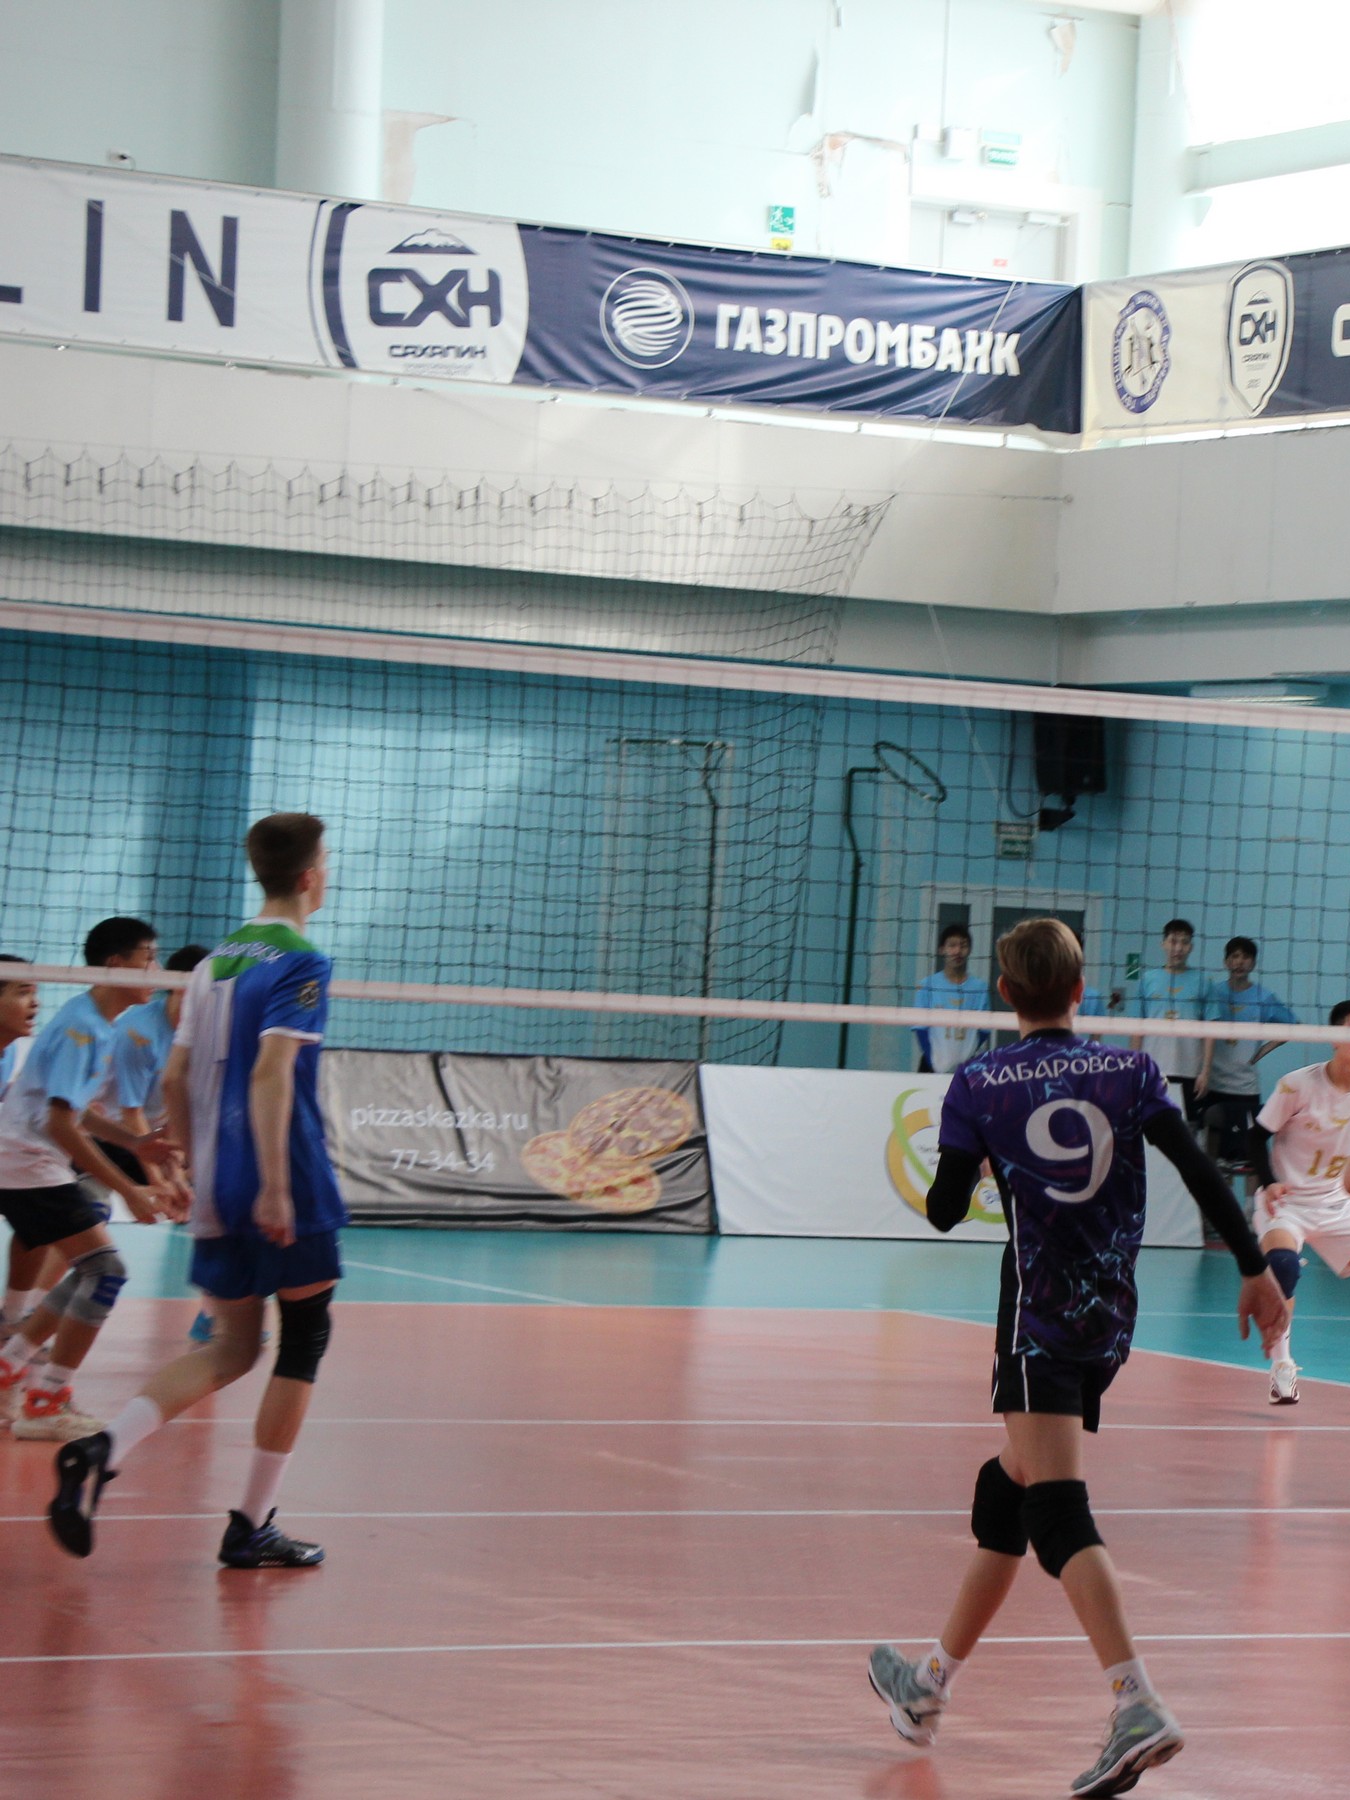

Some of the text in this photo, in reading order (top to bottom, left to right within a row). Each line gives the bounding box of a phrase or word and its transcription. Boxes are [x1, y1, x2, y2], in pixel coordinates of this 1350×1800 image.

[0, 199, 239, 327] IN
[714, 304, 1022, 377] ГАЗПРОМБАНК
[983, 1055, 1136, 1088] ХАБАРОВСК
[350, 1103, 529, 1132] pizzaskazka.ru
[1025, 1098, 1114, 1203] 9
[1307, 1149, 1348, 1179] 18
